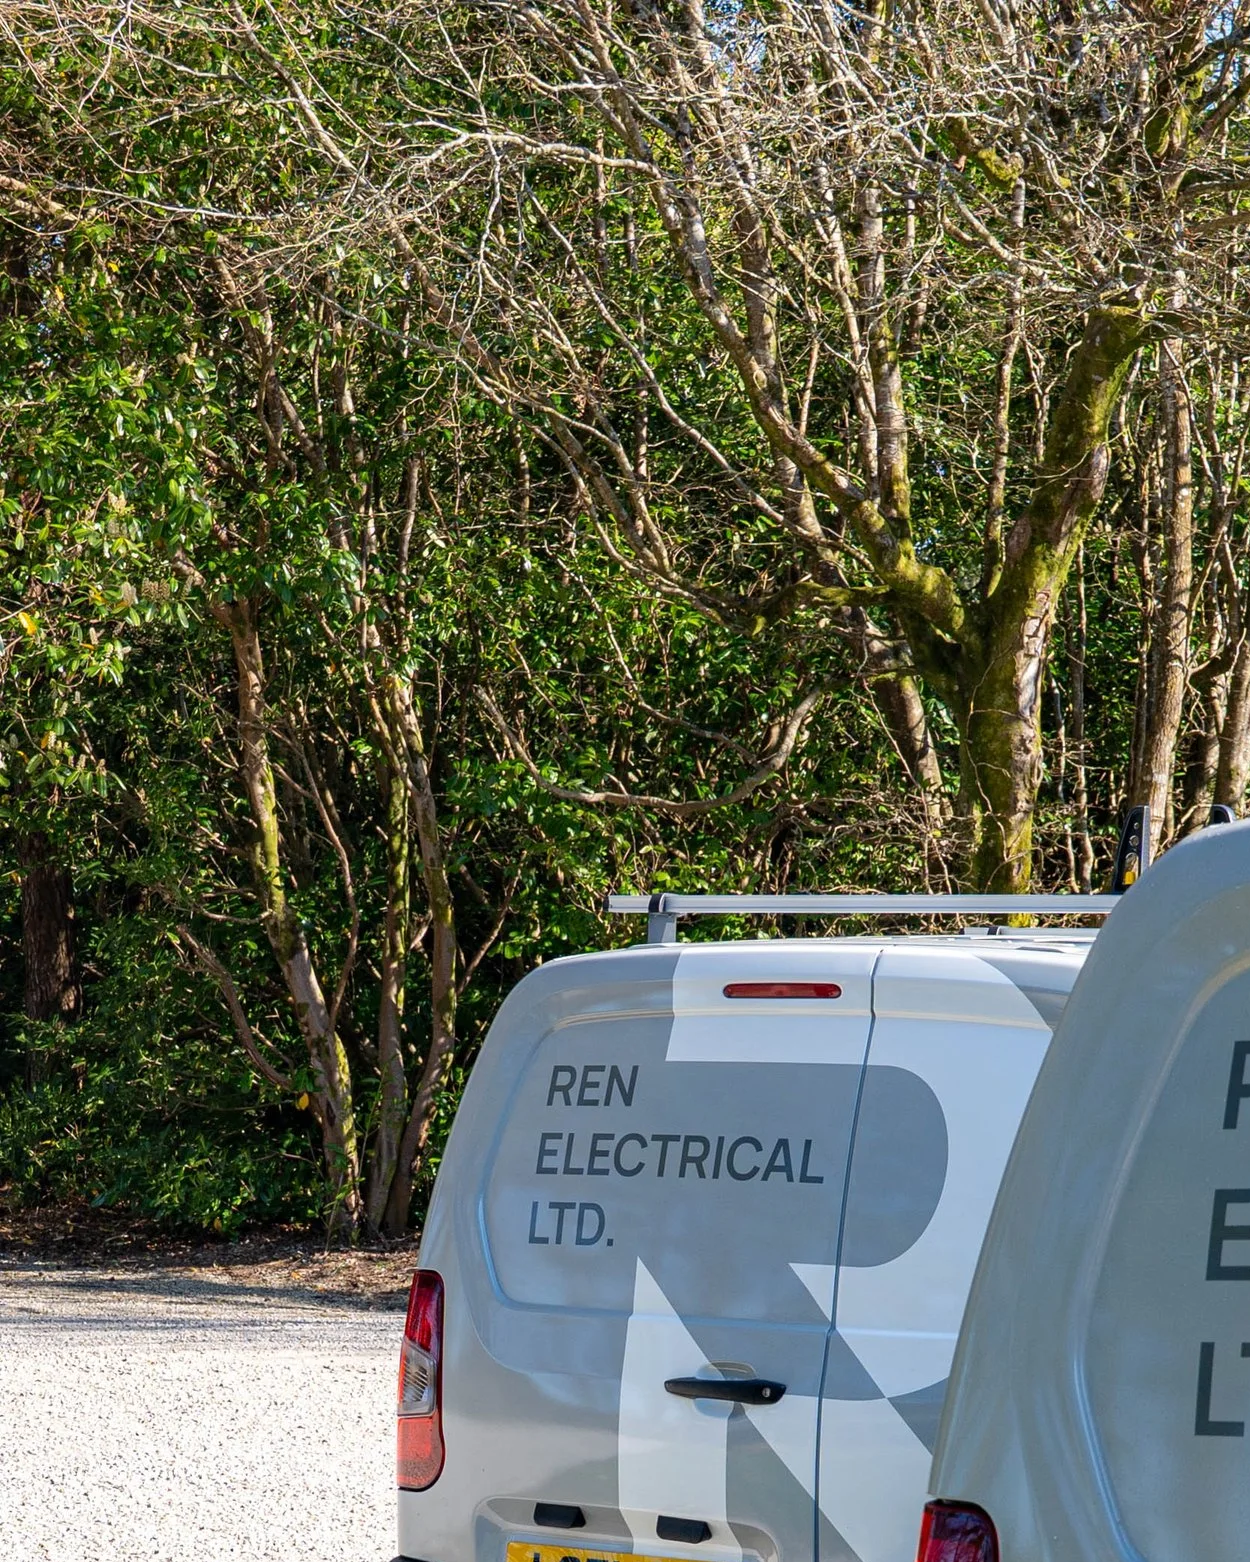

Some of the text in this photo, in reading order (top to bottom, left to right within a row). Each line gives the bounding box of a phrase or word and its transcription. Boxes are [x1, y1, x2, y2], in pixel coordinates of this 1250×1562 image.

[546, 1064, 640, 1107] REN
[536, 1132, 825, 1185] ELECTRICAL
[528, 1200, 614, 1247] LTD.
